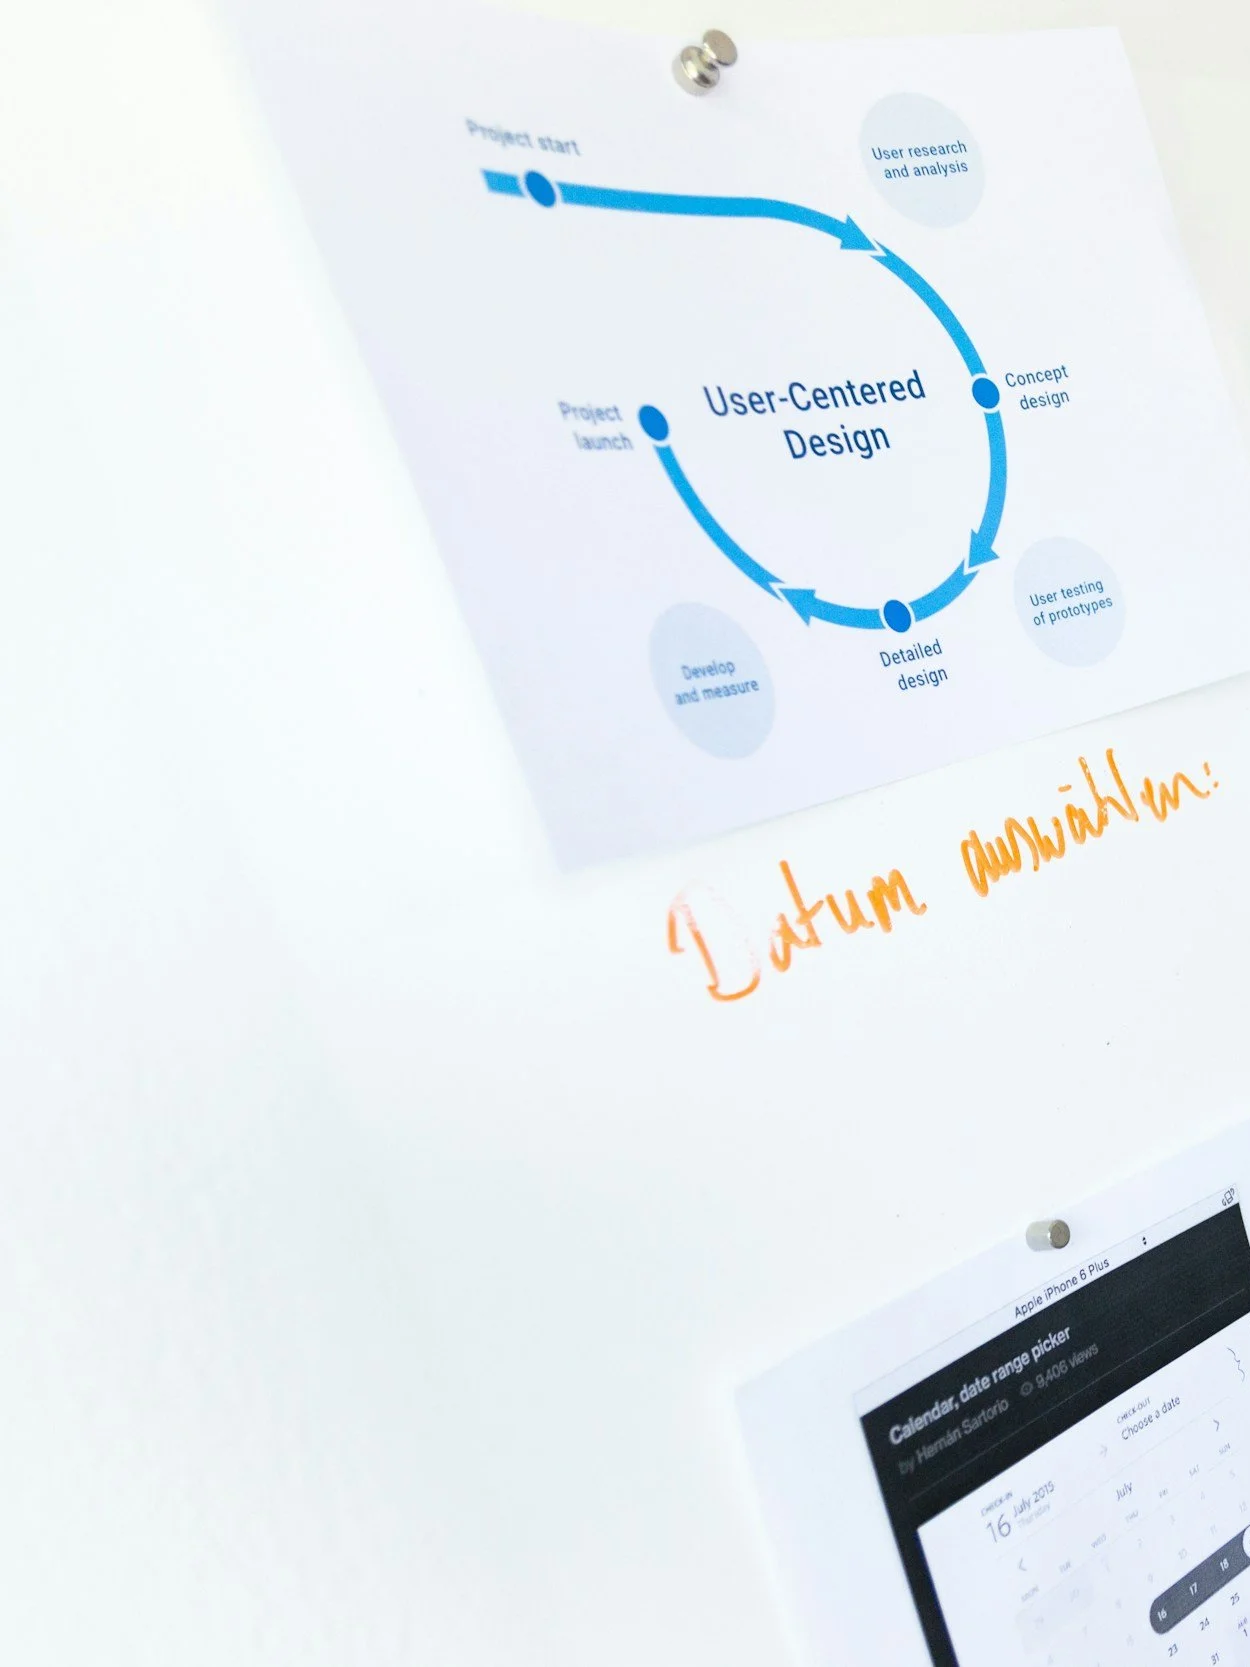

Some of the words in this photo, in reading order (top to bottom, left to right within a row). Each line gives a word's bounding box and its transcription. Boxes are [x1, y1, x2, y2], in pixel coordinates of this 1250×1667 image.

[466, 119, 534, 150] Project
[538, 134, 581, 156] start
[872, 145, 904, 161] User
[907, 141, 967, 157] research
[884, 164, 909, 180] and
[913, 158, 969, 177] analysis
[1005, 365, 1069, 388] Concept
[704, 370, 926, 418] User-Centered
[1020, 388, 1070, 411] design
[558, 402, 622, 424] Project
[575, 431, 633, 451] launch
[783, 424, 890, 460] Design
[1030, 590, 1056, 607] User
[1059, 578, 1104, 604] testing
[1032, 612, 1047, 626] of
[1048, 595, 1113, 624] prototypes
[880, 639, 943, 667] Detailed
[681, 659, 736, 681] Develop
[898, 666, 948, 691] design
[675, 689, 699, 705] and
[702, 678, 759, 702] measure
[666, 858, 927, 1001] Datum
[1014, 1297, 1043, 1318] Apple
[1044, 1276, 1078, 1300] iPhone
[1079, 1269, 1087, 1281] 6
[1088, 1258, 1110, 1277] Plus
[889, 1395, 959, 1445] Calendar,
[959, 1376, 991, 1404] date
[991, 1352, 1030, 1384] range
[1031, 1326, 1071, 1364] picker
[898, 1455, 915, 1475] by
[915, 1427, 962, 1463] Hernán
[962, 1398, 1010, 1435] Sartorio
[1035, 1361, 1068, 1389] 9,406
[1069, 1343, 1099, 1367] views
[1116, 1396, 1151, 1424] CHECK-OUT
[1121, 1414, 1154, 1440] Choose
[1155, 1409, 1161, 1418] a
[1161, 1396, 1180, 1414] date
[1013, 1497, 1032, 1518] July
[1032, 1480, 1055, 1504] 2015
[1116, 1482, 1133, 1502] July
[986, 1513, 1011, 1544] 16
[1157, 1607, 1168, 1622] 16
[1189, 1582, 1198, 1596] 17
[1219, 1558, 1229, 1572] 18
[1168, 1643, 1179, 1658] 23
[1199, 1617, 1210, 1631] 24
[1230, 1592, 1240, 1606] 25
[1211, 1652, 1220, 1666] 31
